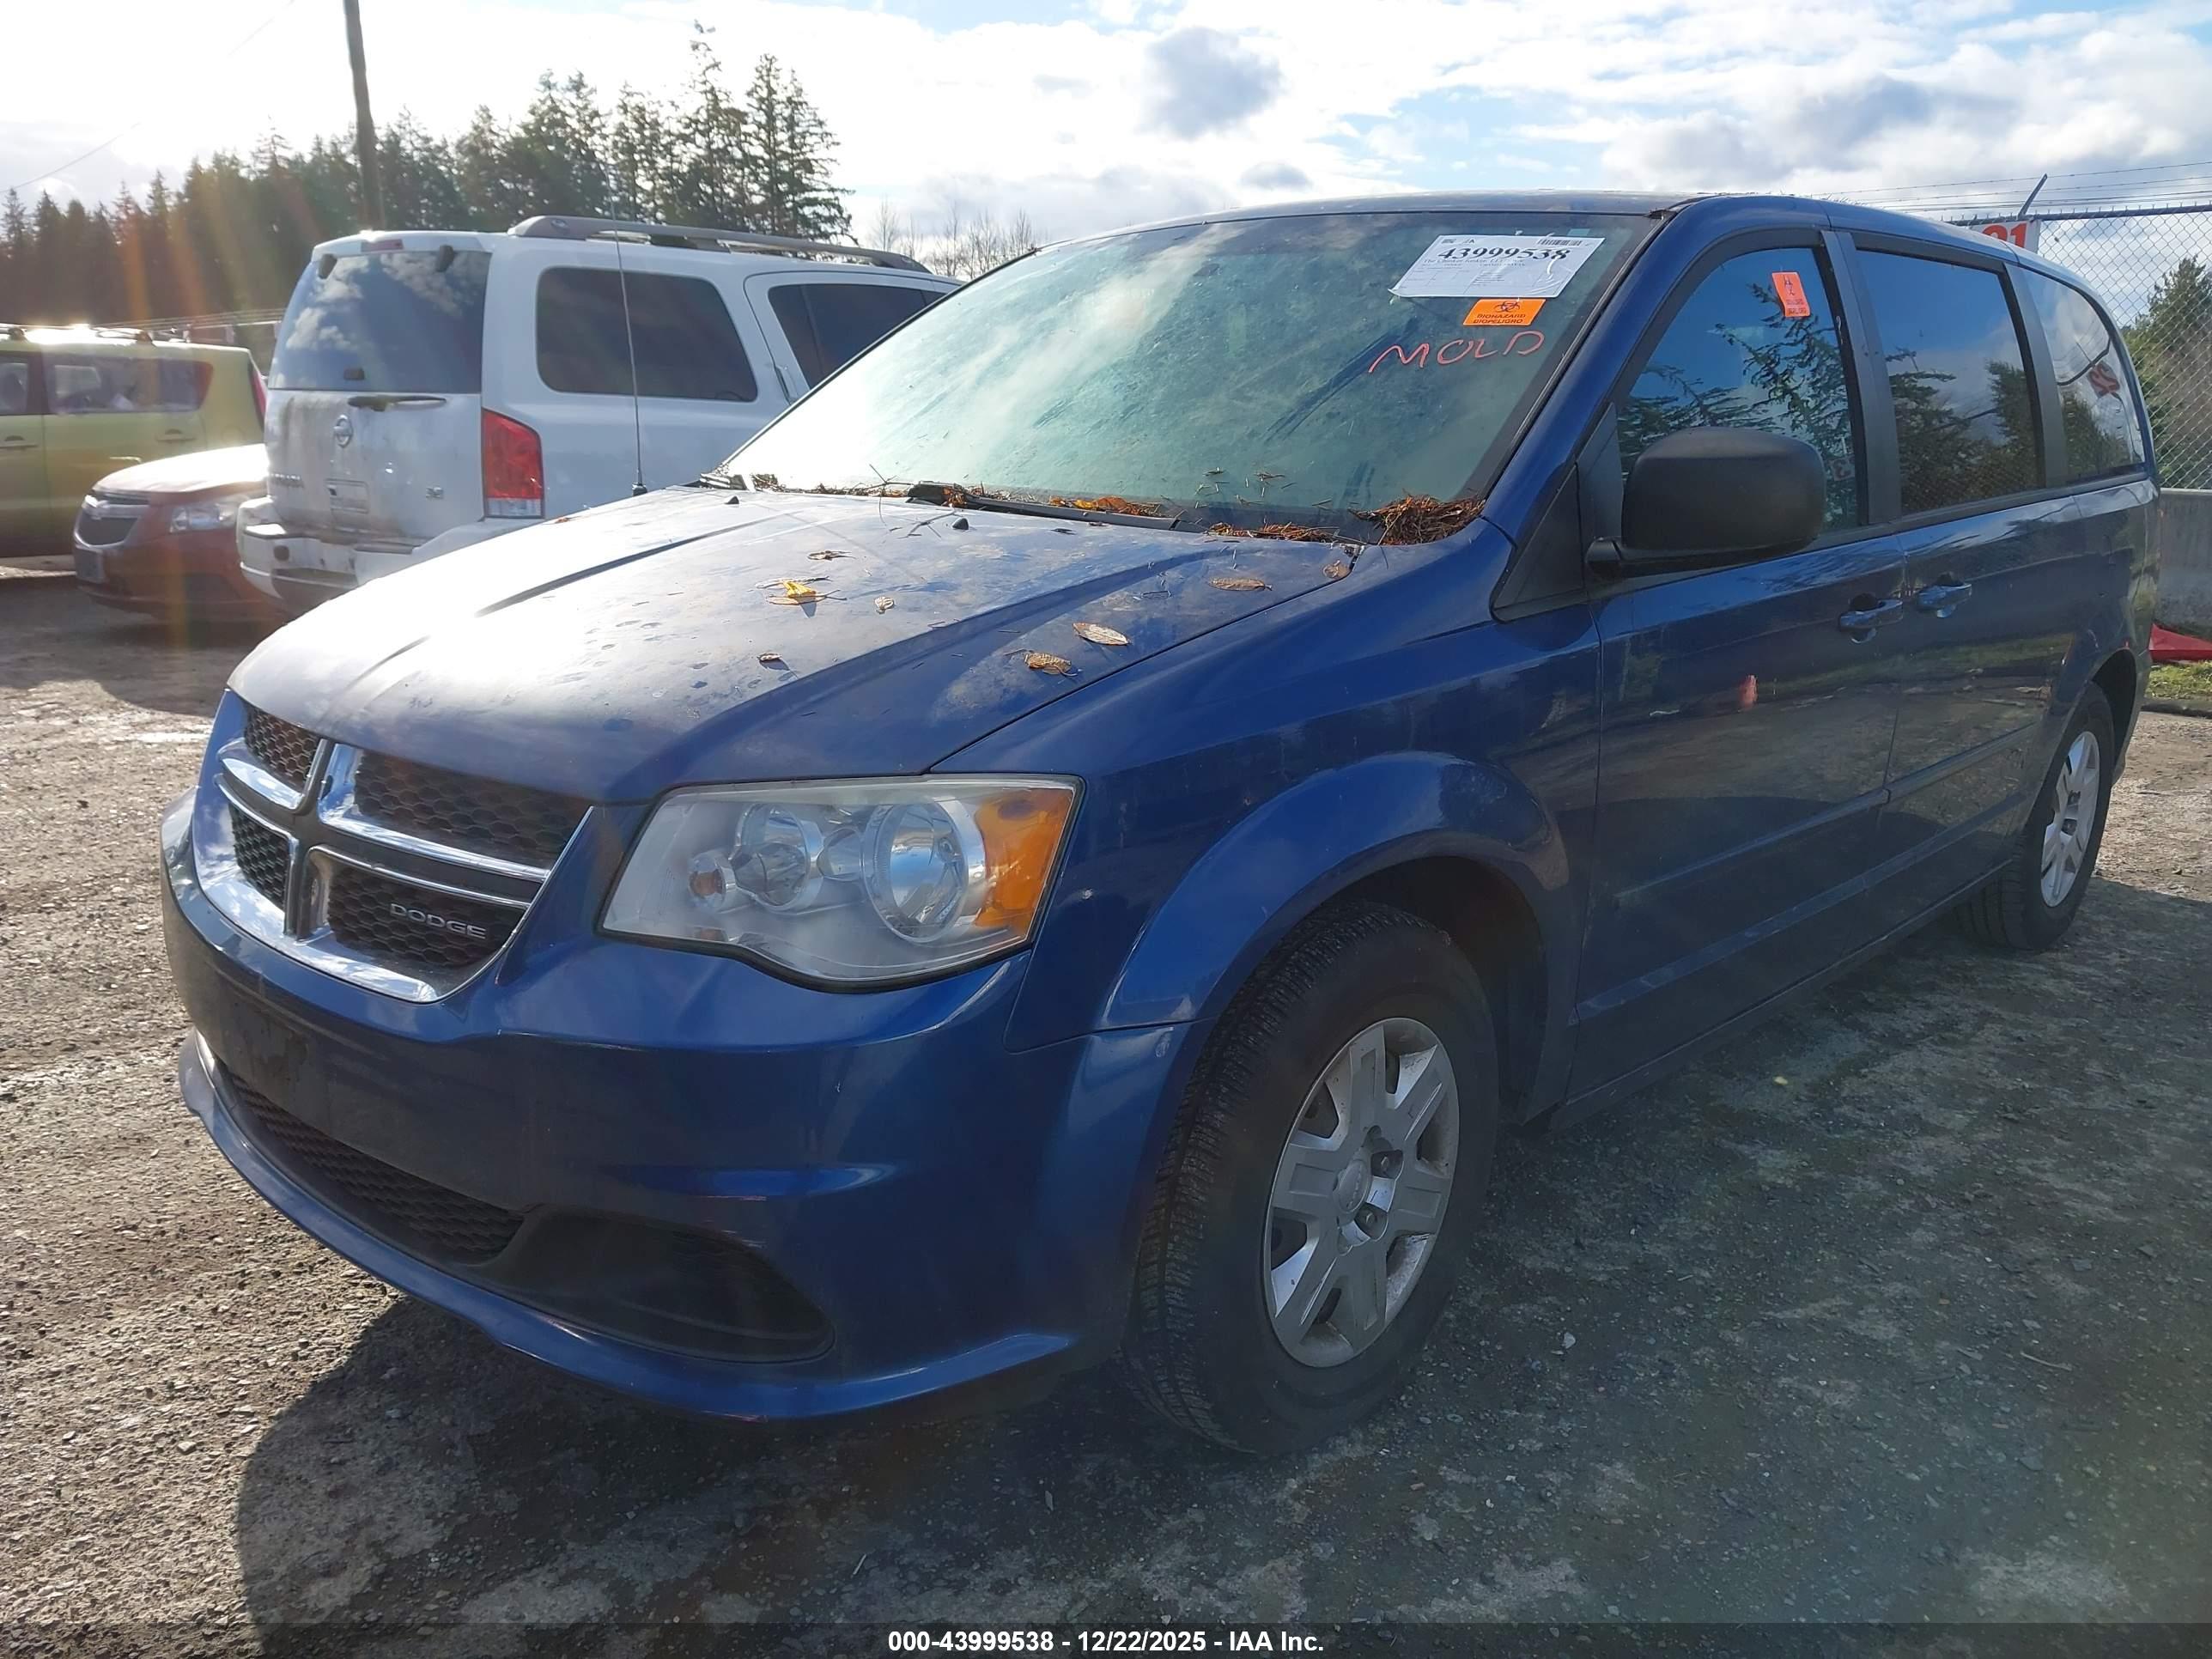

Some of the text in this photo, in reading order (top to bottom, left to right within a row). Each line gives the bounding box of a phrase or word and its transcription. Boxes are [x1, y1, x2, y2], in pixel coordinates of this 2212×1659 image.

[1437, 246, 1571, 260] 43999538
[1368, 330, 1546, 374] MOLD
[391, 902, 486, 939] DODGE
